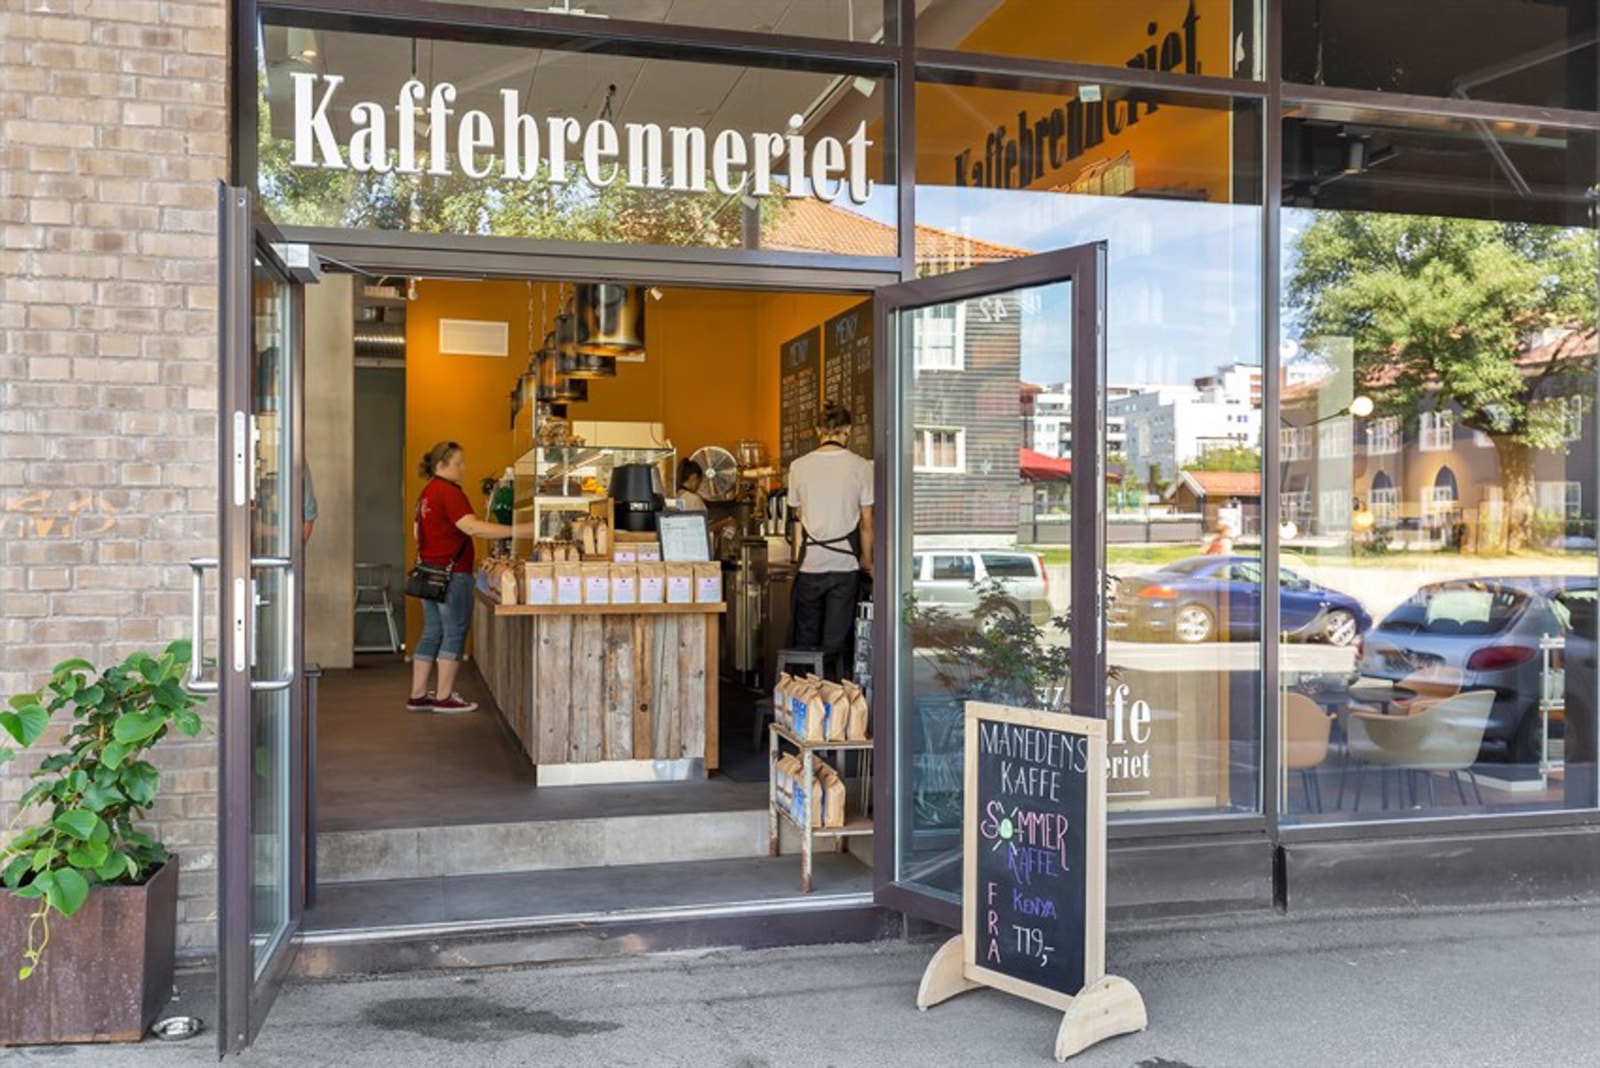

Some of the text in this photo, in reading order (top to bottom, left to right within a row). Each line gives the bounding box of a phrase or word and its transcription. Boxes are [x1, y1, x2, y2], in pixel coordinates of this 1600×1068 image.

[289, 71, 874, 204] Kaffebrenneriet
[1001, 760, 1060, 802] KAFFE
[980, 800, 1069, 871] SOMMER
[1008, 846, 1058, 886] KAFFE
